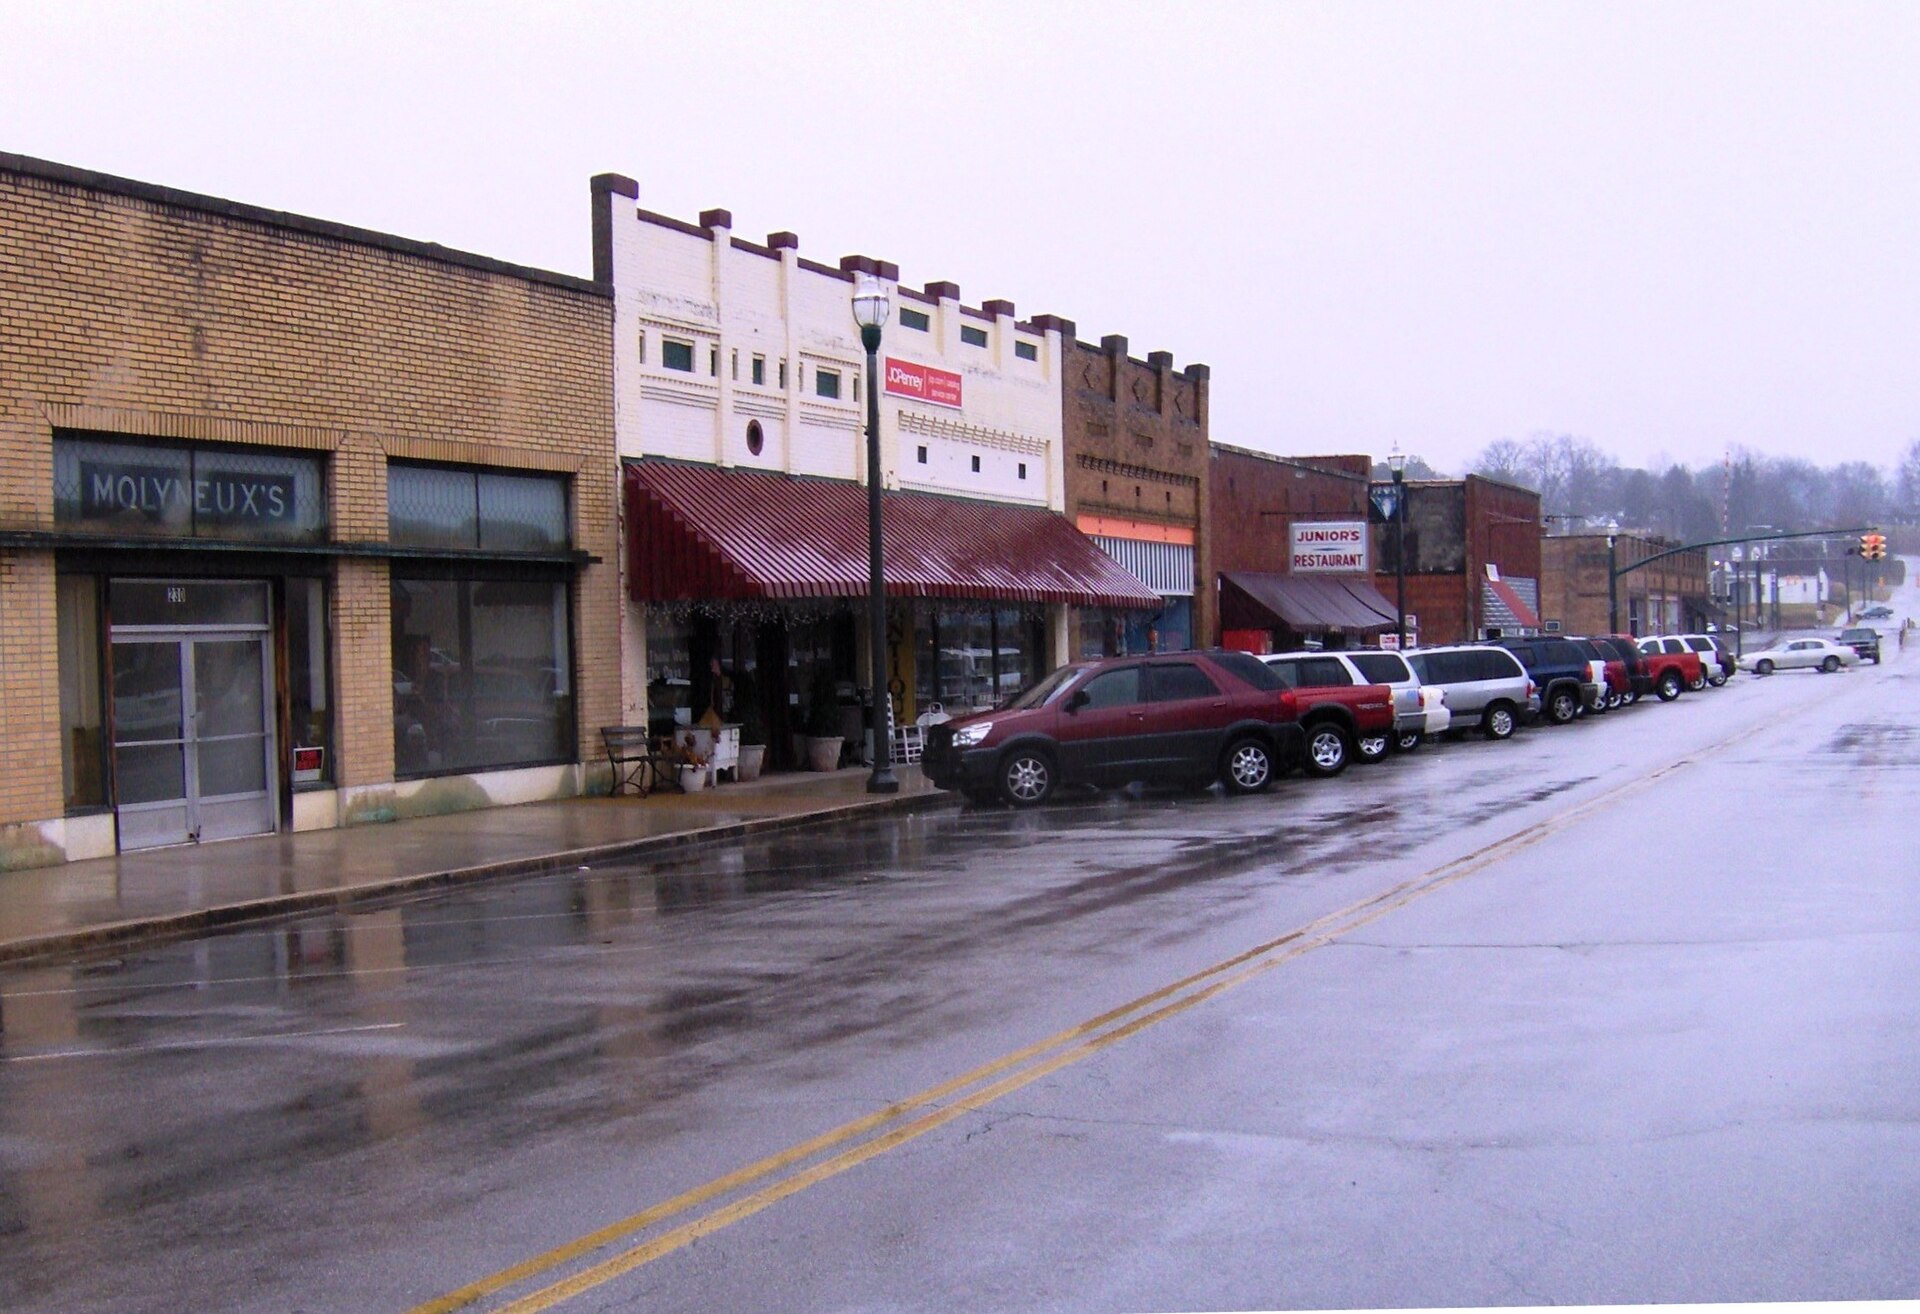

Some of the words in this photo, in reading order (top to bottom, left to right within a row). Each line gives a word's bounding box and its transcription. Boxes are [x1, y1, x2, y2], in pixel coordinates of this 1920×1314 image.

[93, 473, 285, 518] MOLYNEUX'S
[1297, 530, 1360, 542] JUNIOR'S
[1294, 554, 1363, 567] RESTAURANT
